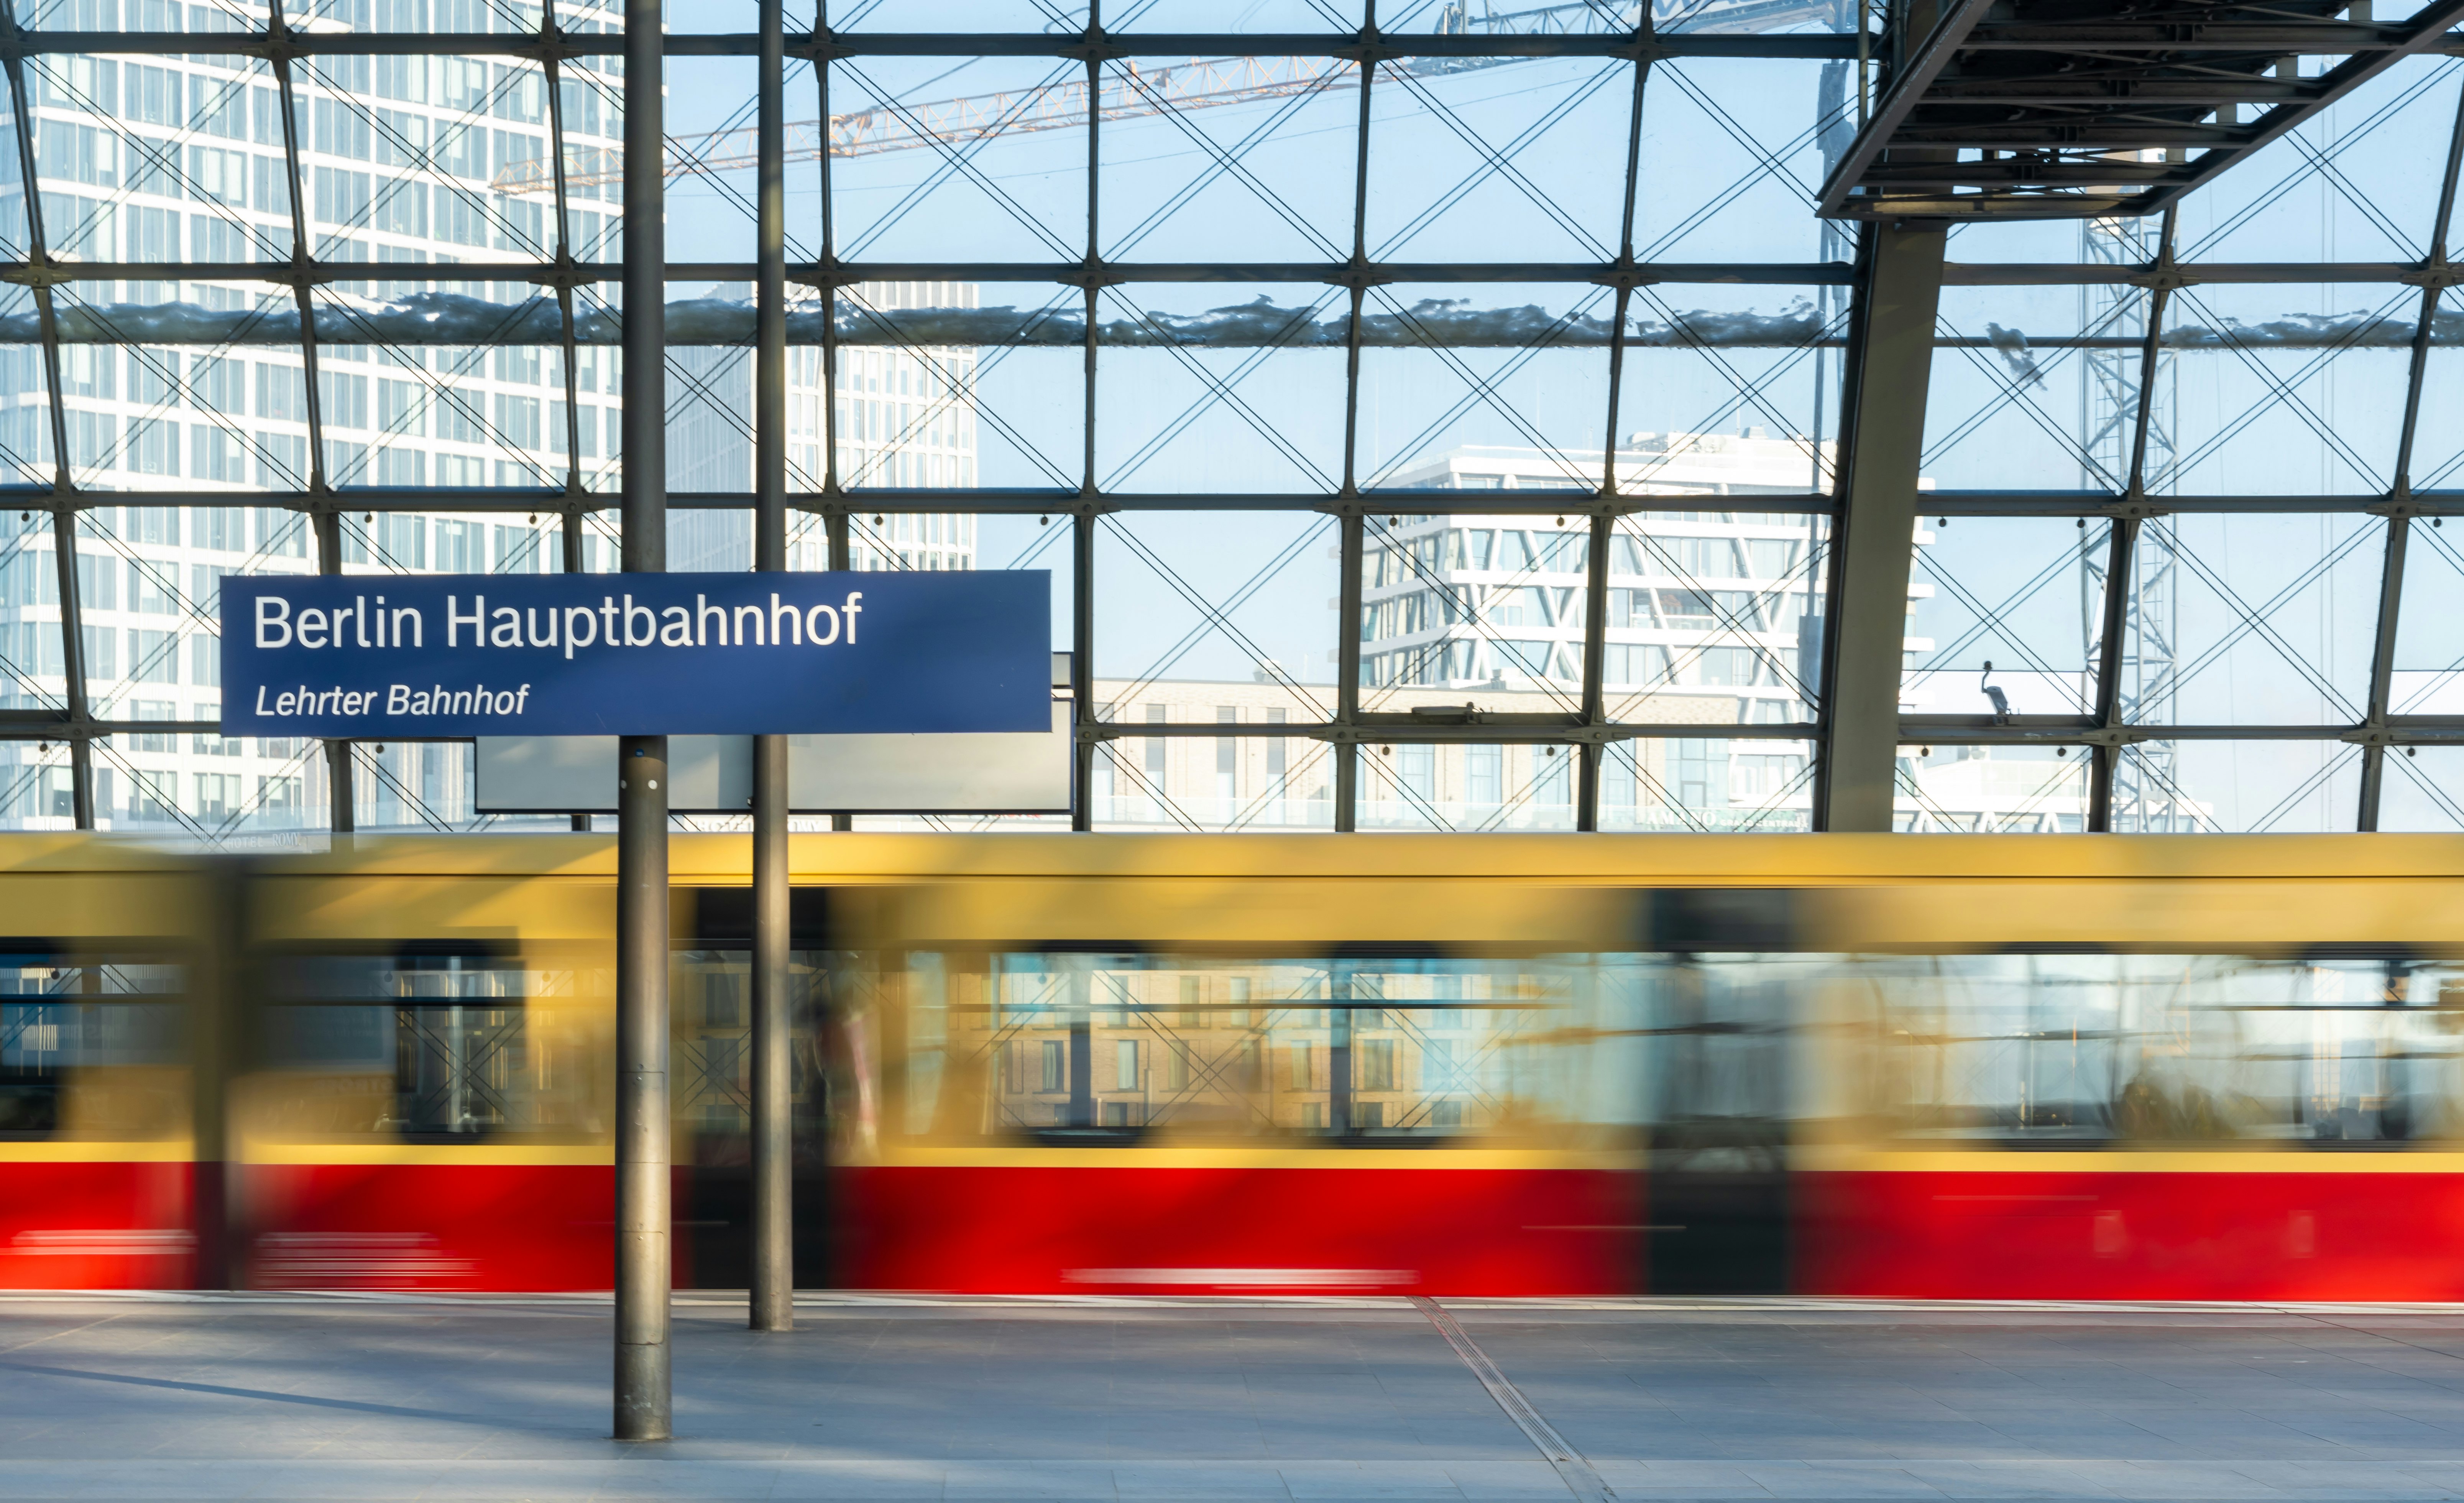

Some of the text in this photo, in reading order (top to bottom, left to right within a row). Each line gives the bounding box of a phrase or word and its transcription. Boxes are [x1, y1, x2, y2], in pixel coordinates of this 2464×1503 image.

[256, 592, 863, 659] Berlin Hauptbahnhof
[255, 684, 531, 716] Lehrter Bahnhof
[1645, 810, 1717, 826] AMANO
[227, 836, 263, 849] HOTEL
